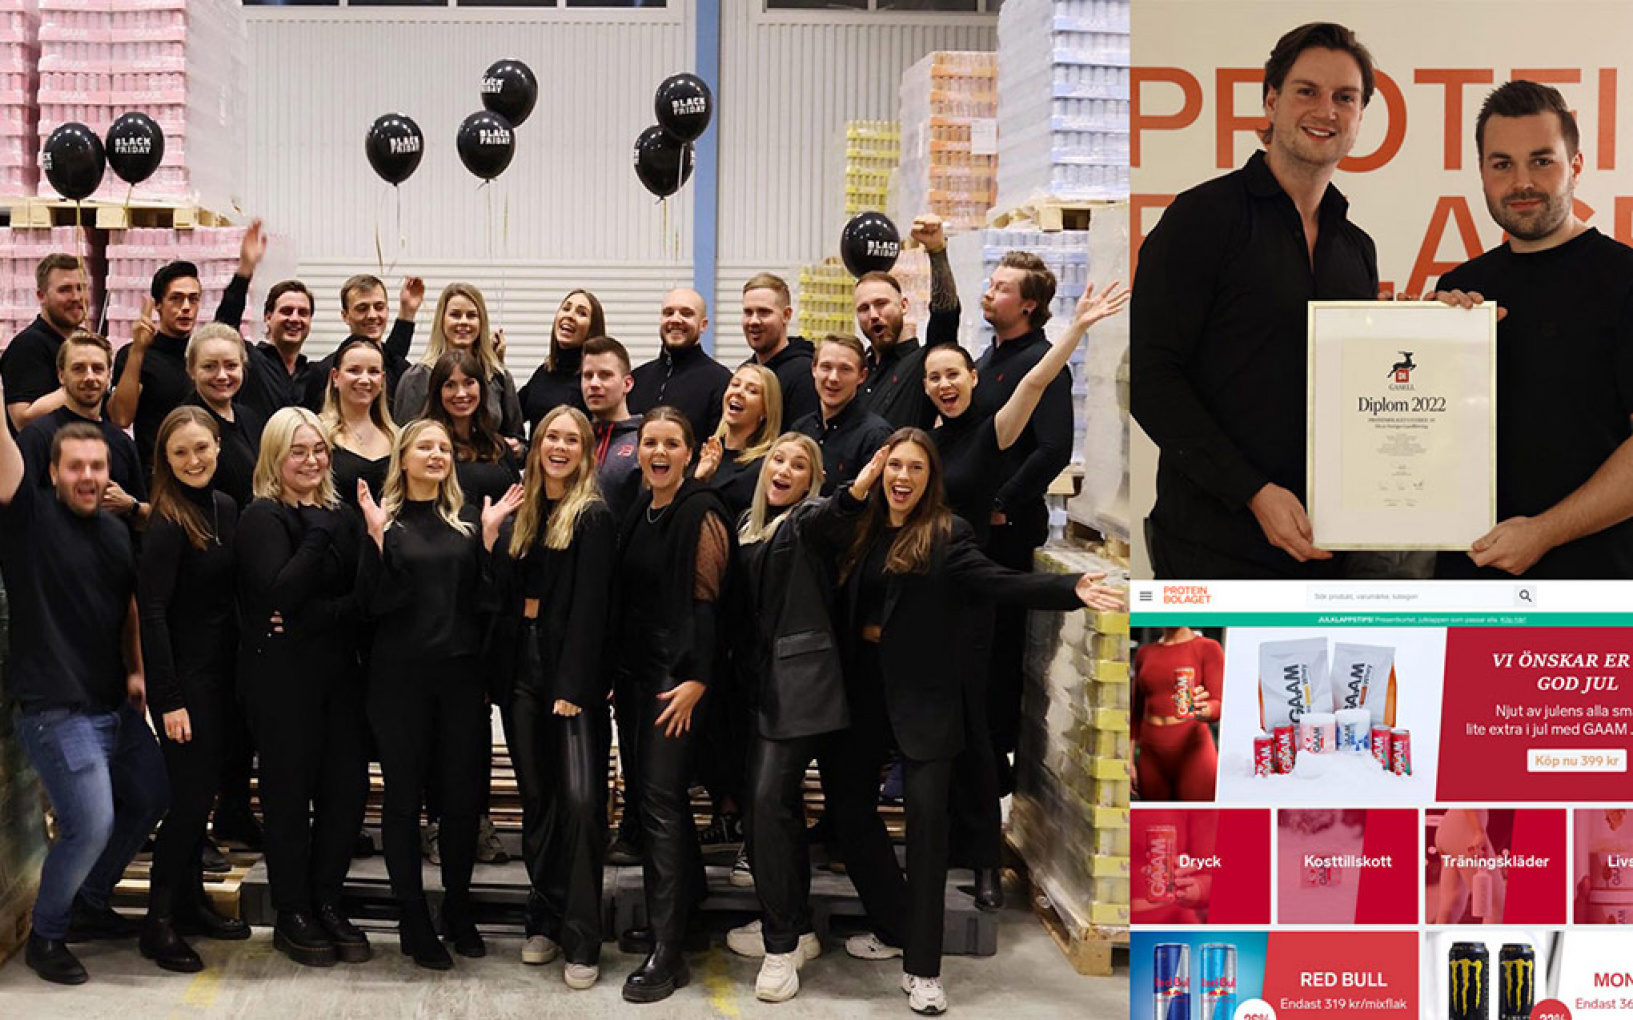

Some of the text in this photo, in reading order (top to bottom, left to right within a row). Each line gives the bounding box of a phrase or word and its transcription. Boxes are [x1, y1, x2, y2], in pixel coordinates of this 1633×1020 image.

[672, 97, 705, 108] BLACK
[673, 105, 706, 115] FRIDAY
[115, 137, 151, 146] BLACK
[115, 146, 151, 154] FRIDAY
[867, 240, 898, 249] BLACK
[1358, 397, 1446, 415] Diplom 2022
[1164, 586, 1207, 594] PROTEIN
[1164, 595, 1212, 604] BOLAGET
[1493, 650, 1630, 668] VI ÖNSKAR ER
[1344, 663, 1365, 709] AAM
[1537, 676, 1619, 694] GOD JUL
[1284, 664, 1305, 723] GAAM
[1496, 704, 1523, 719] Njut
[1526, 707, 1542, 717] av
[1543, 704, 1583, 719] julens
[1586, 704, 1609, 717] alla
[1466, 722, 1627, 738] lite extra i jul med GAAM
[1535, 756, 1618, 767] Köp nu 399 kr
[1150, 839, 1166, 897] GAAM
[1179, 855, 1221, 870] Dryck
[1304, 855, 1392, 868] Kosttillskott
[1441, 855, 1550, 870] Träningskläder
[1174, 977, 1189, 987] Bul
[1220, 977, 1236, 987] Bul
[1300, 971, 1388, 987] RED BULL
[1594, 973, 1633, 987] MON
[1280, 998, 1407, 1009] Endast 319 kr/mixflak
[1575, 999, 1616, 1009] Endast
